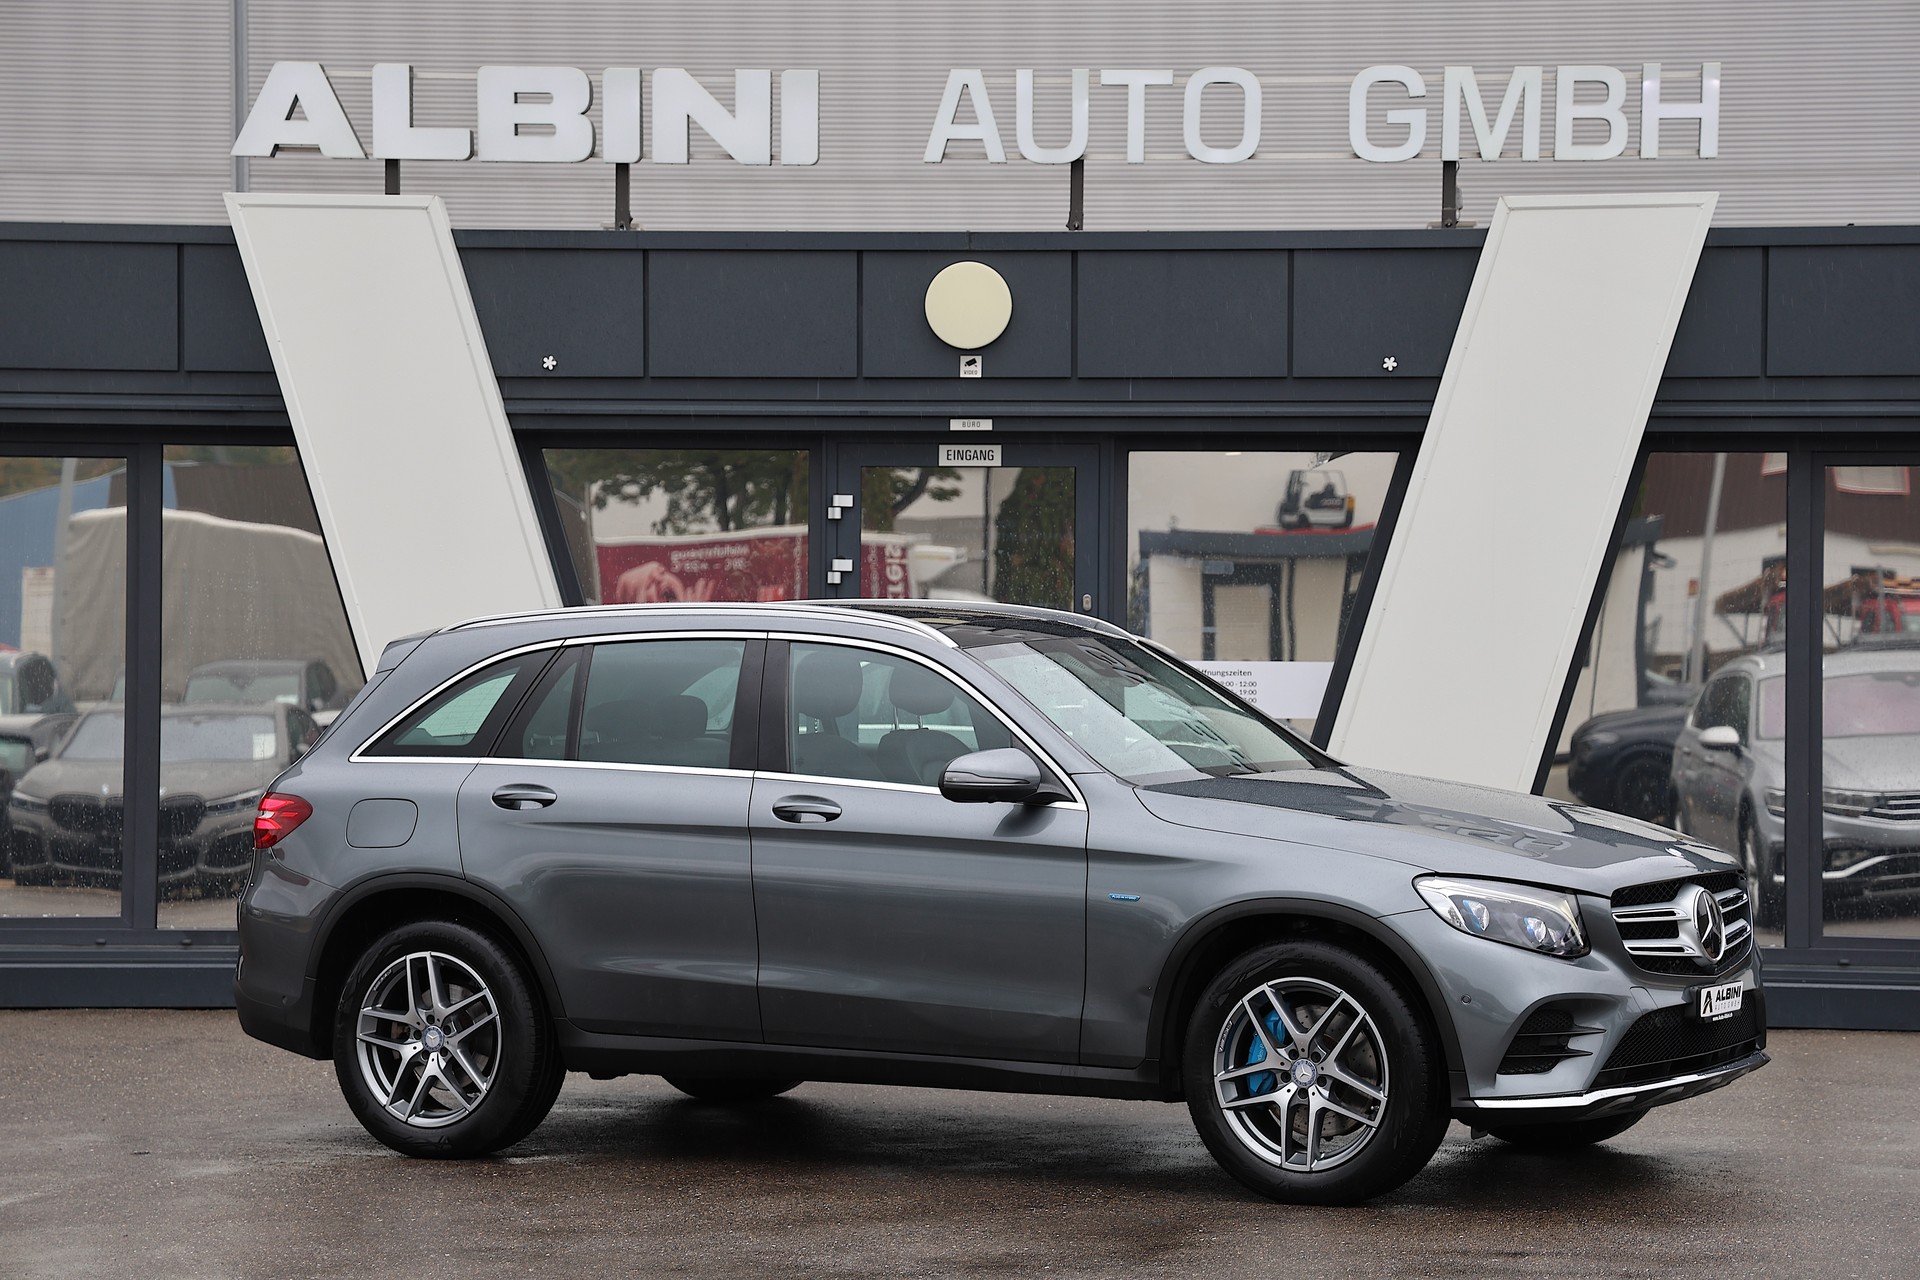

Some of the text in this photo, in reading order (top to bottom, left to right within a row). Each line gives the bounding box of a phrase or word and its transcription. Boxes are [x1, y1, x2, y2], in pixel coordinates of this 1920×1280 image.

[230, 61, 1722, 167] ALBINI AUTO GMBH
[962, 420, 981, 428] BÜRO
[946, 449, 995, 461] EINGANG
[1716, 985, 1741, 1002] ALBINI
